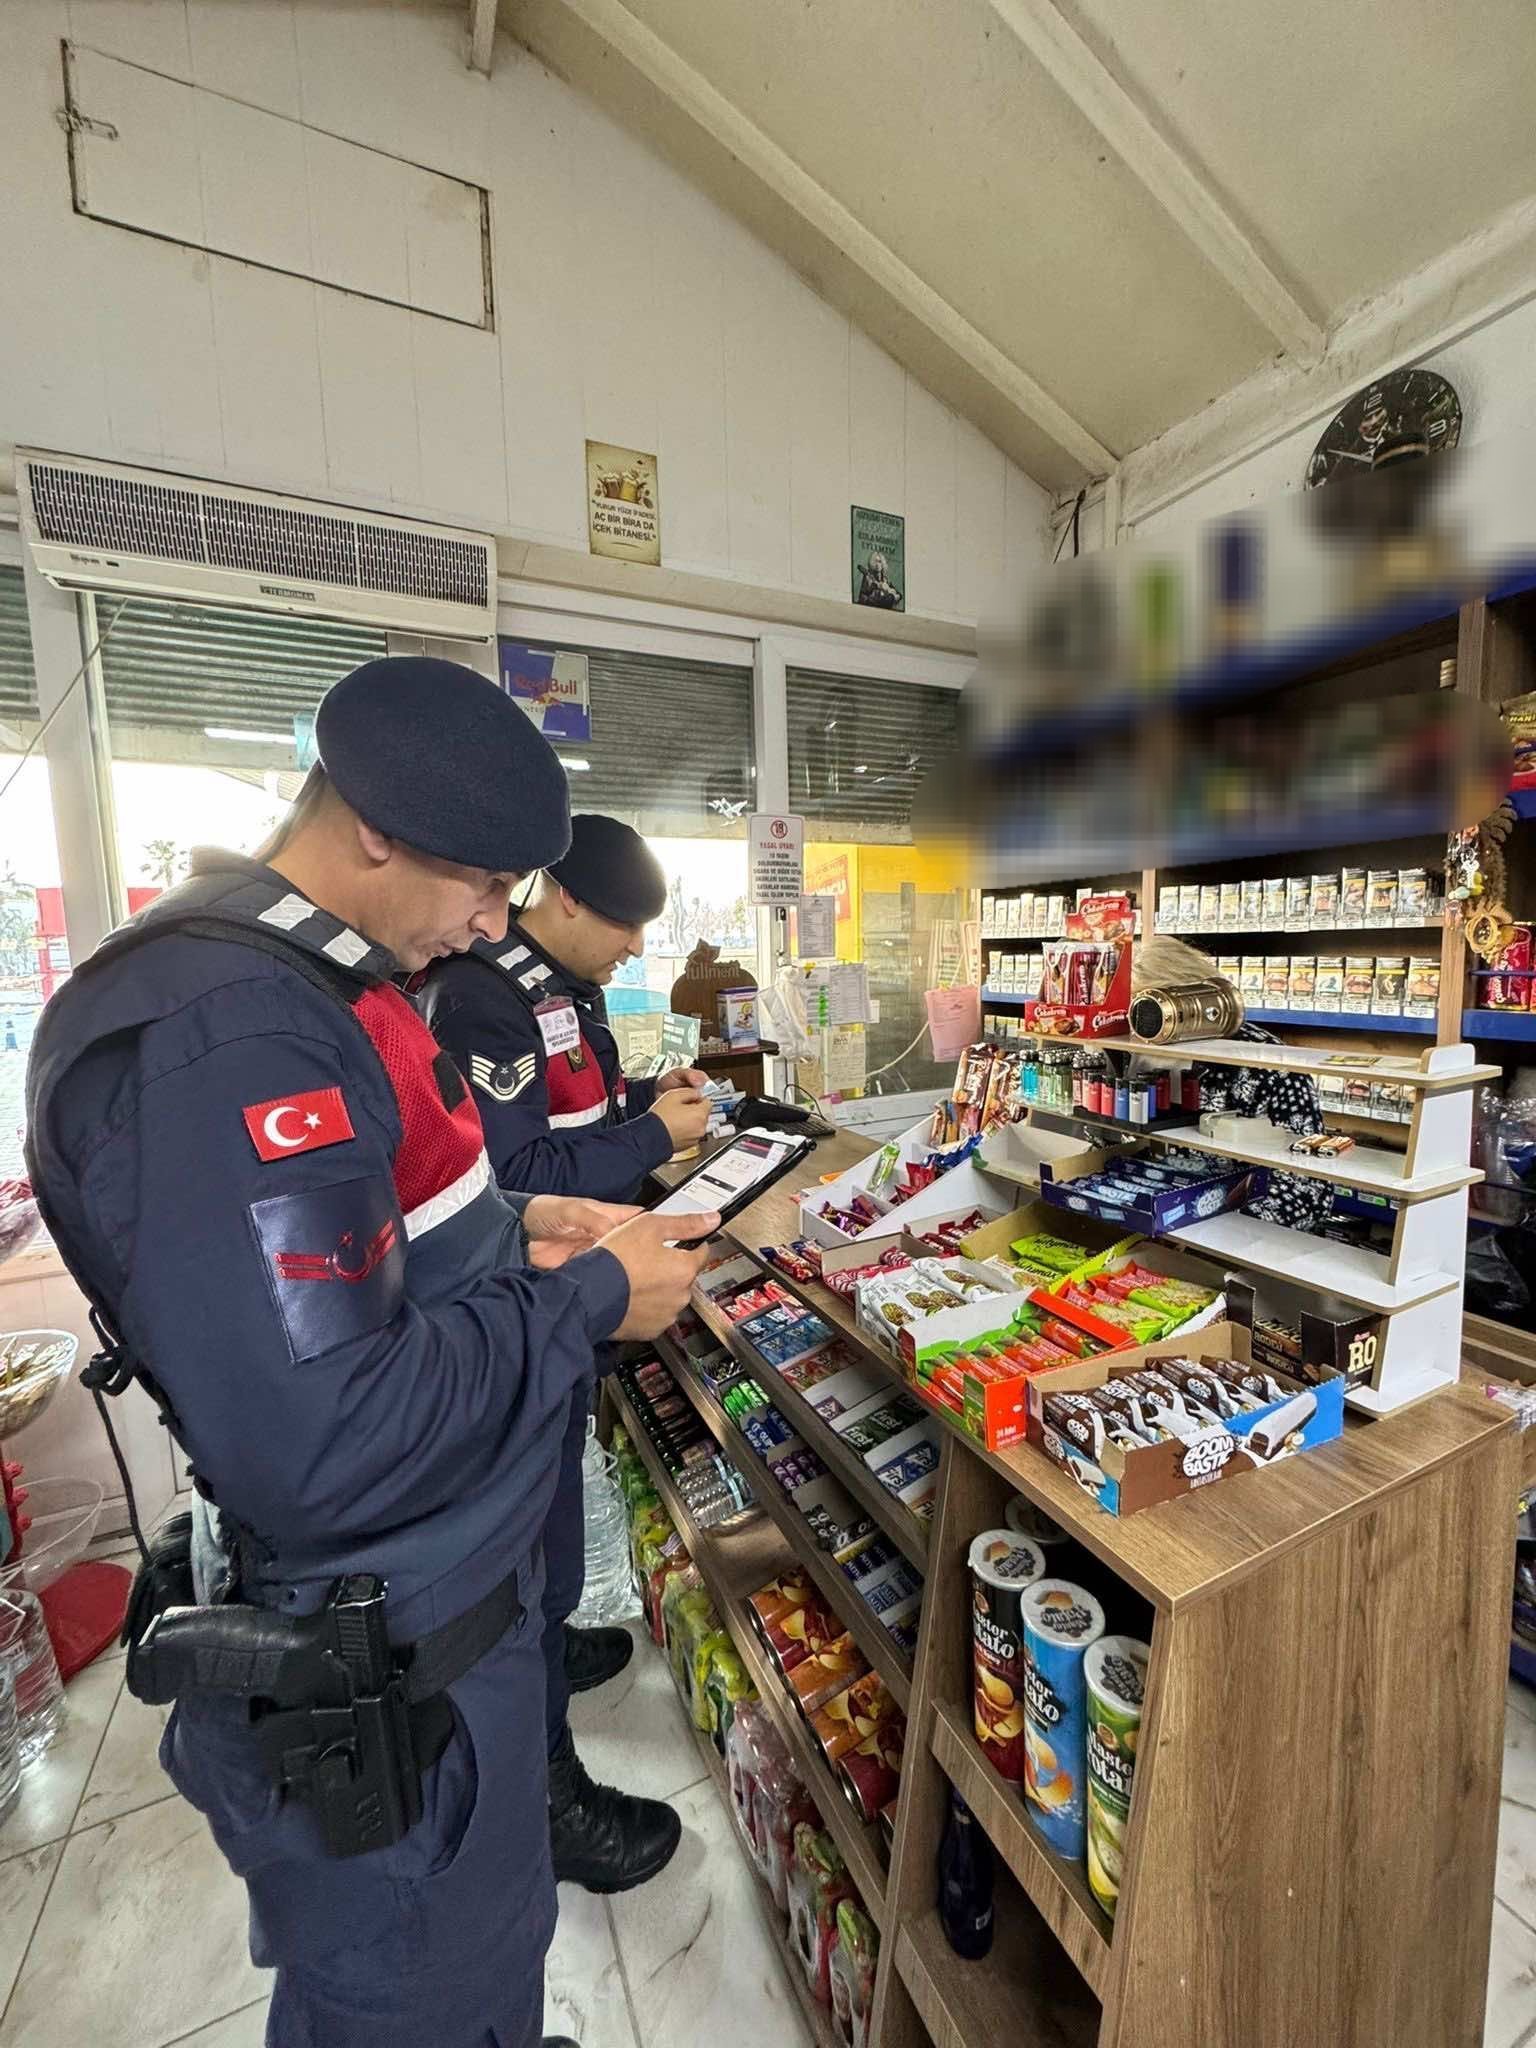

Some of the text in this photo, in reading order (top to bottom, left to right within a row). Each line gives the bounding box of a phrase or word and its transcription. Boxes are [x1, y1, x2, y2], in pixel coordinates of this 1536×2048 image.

[607, 514, 621, 523] BİR
[622, 516, 641, 528] BİRA
[642, 521, 655, 530] DA
[550, 679, 577, 695] Bull
[1184, 1435, 1235, 1461] BOOM
